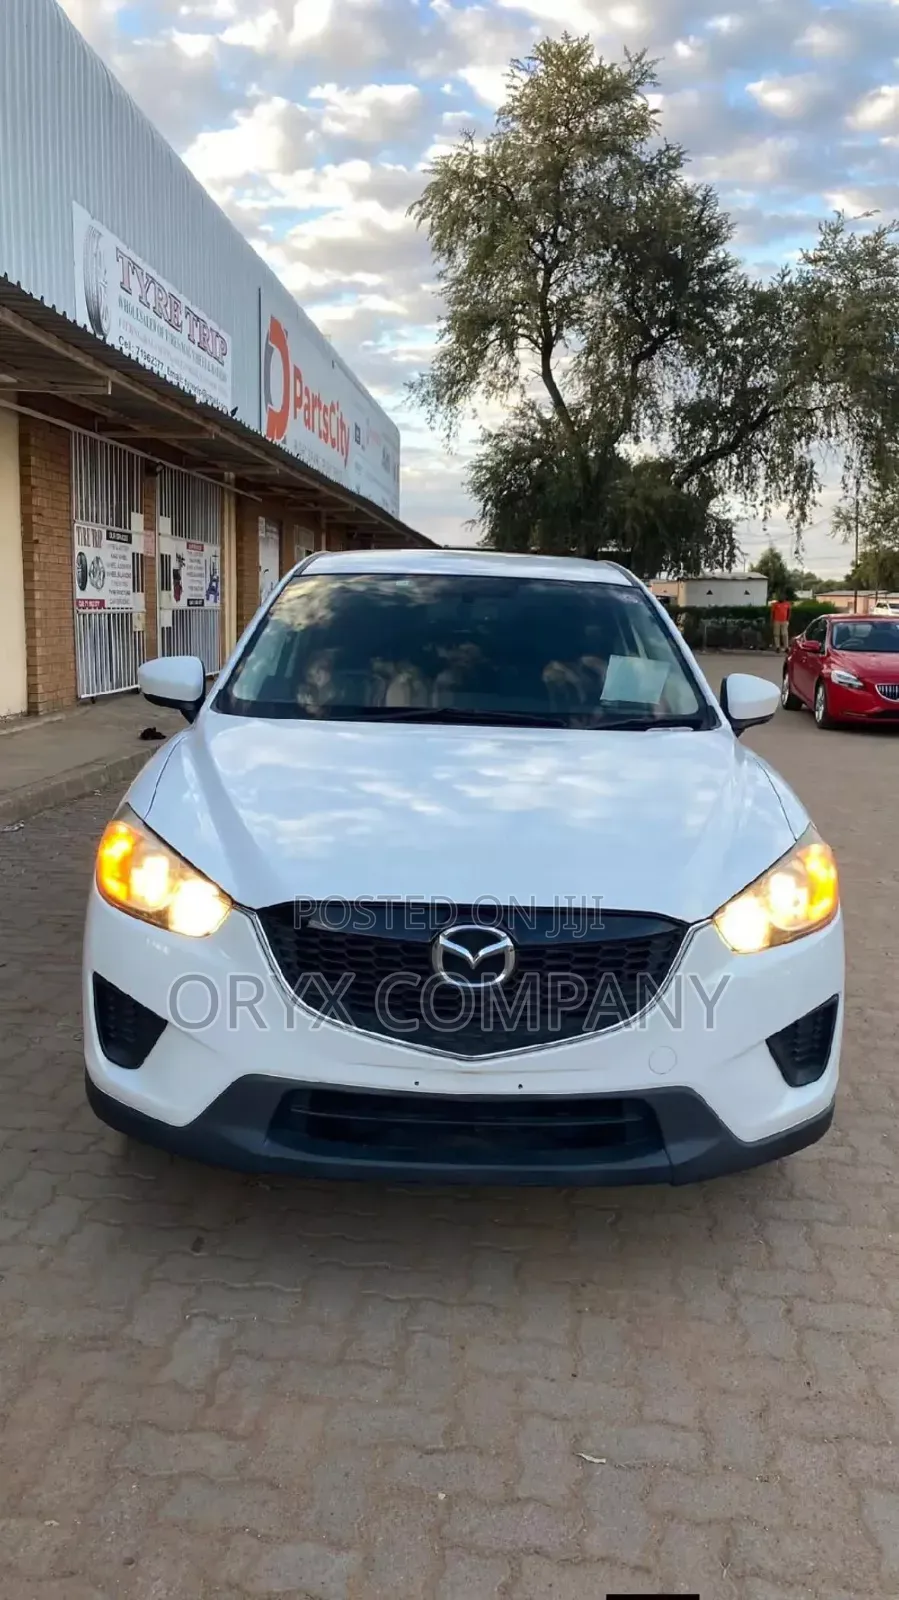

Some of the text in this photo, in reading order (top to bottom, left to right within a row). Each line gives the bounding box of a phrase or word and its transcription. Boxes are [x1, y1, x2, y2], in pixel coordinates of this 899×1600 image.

[116, 247, 183, 333] TYRE
[185, 306, 228, 366] TRIP
[293, 364, 350, 468] PartsCity
